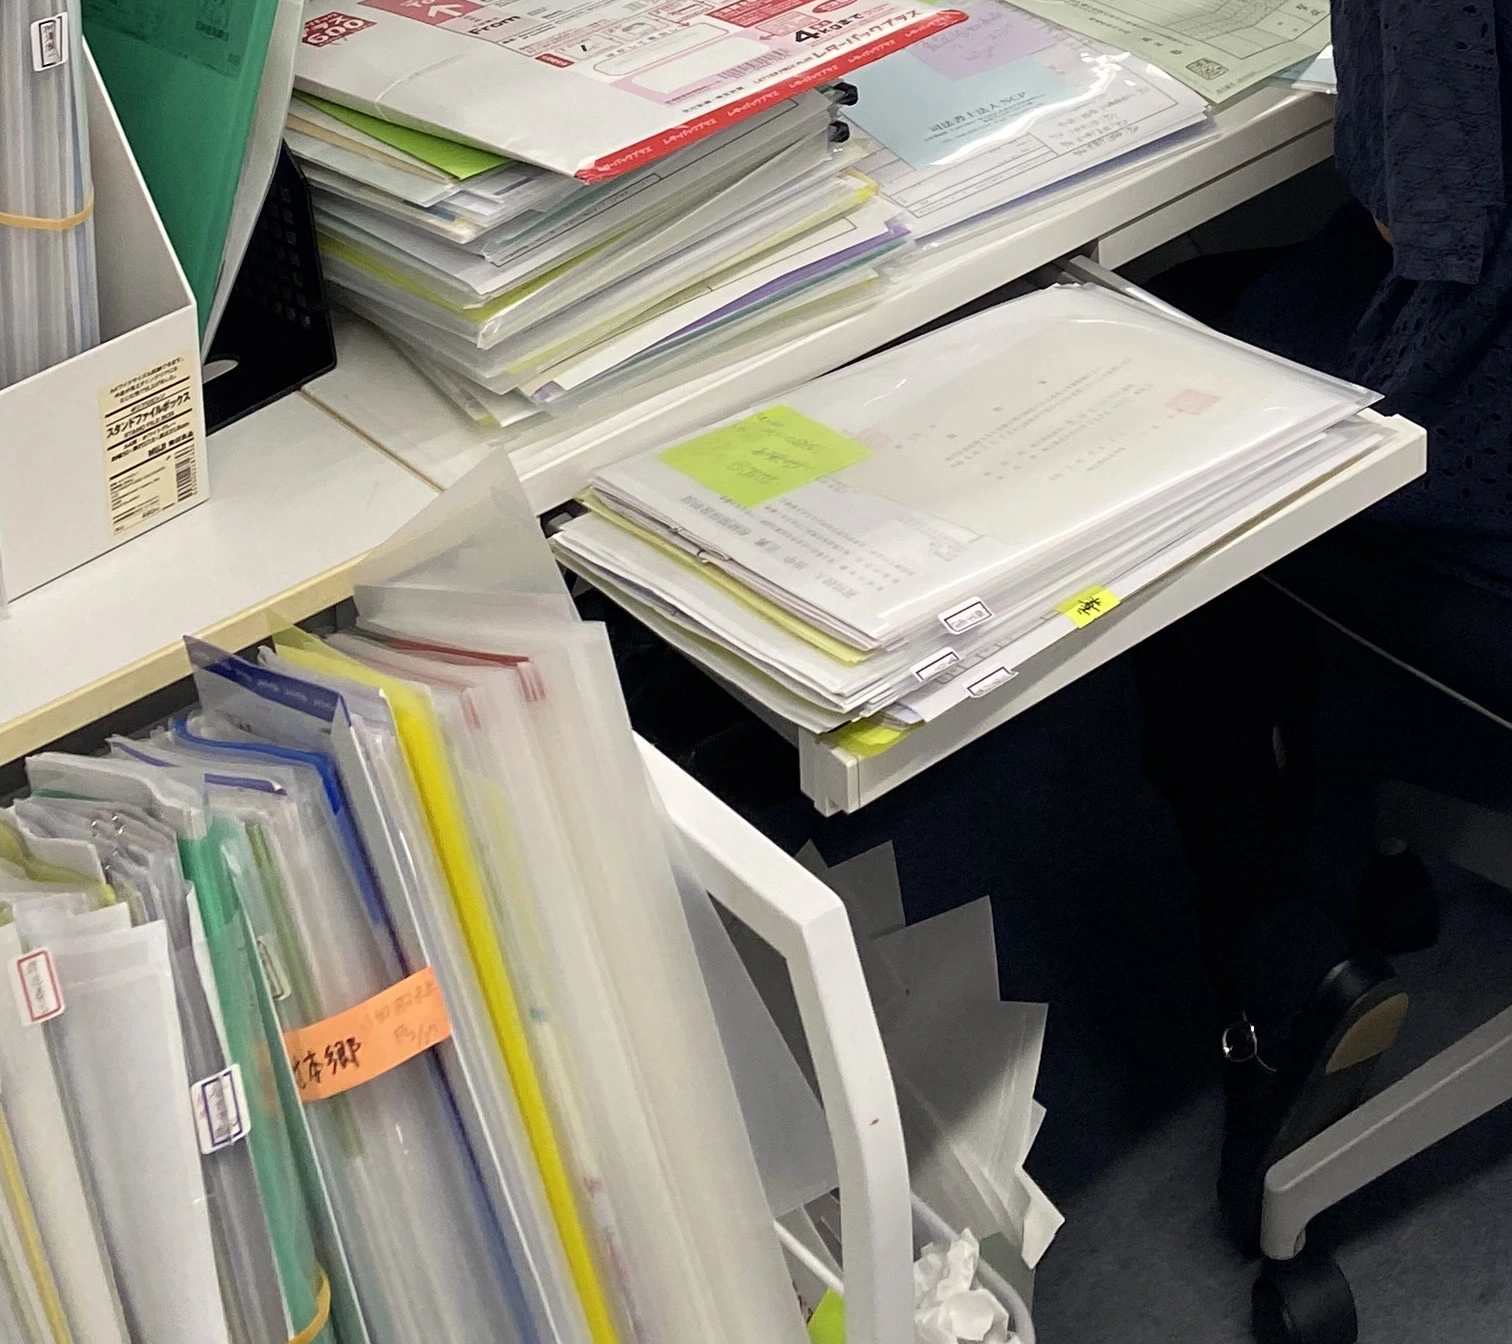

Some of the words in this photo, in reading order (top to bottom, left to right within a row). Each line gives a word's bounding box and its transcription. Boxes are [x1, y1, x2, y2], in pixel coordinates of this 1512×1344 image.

[309, 18, 364, 44] 600
[468, 15, 521, 35] From
[812, 10, 924, 59] レターパックプラス
[106, 391, 191, 439] スタンドファイルボックス
